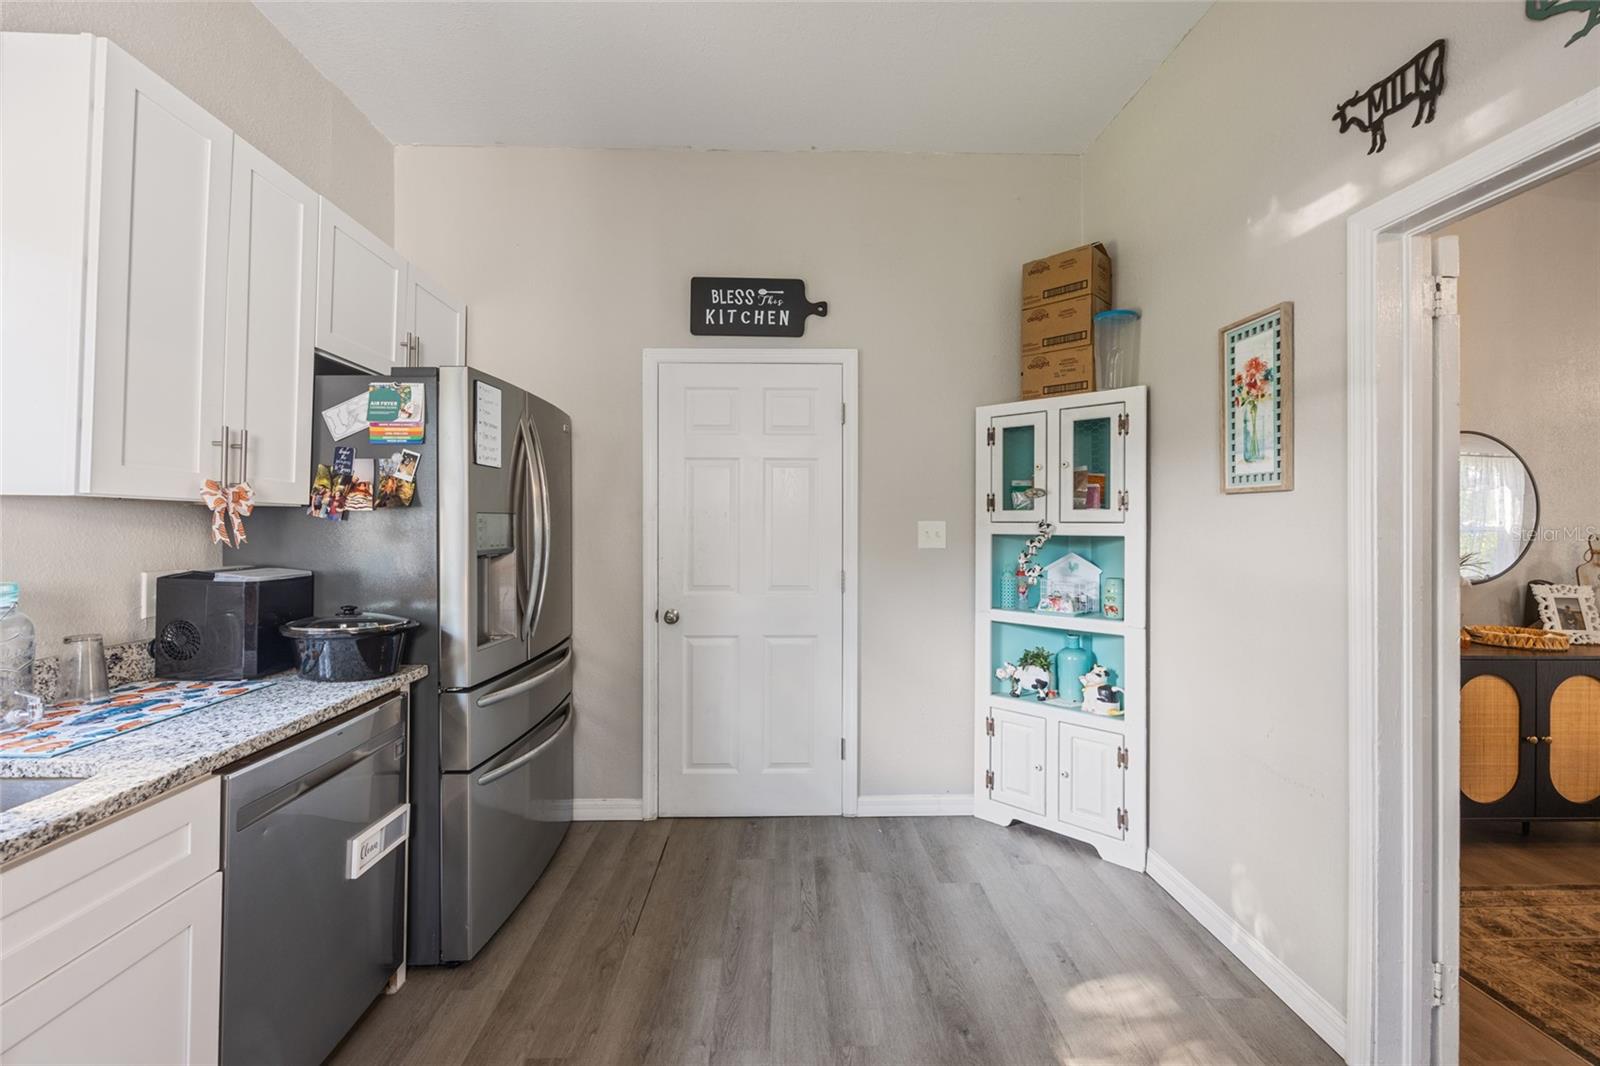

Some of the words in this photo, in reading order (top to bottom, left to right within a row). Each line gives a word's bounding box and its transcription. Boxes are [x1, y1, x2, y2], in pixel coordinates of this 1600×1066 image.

[1367, 49, 1436, 129] MILK
[711, 288, 755, 305] BLESS
[757, 295, 784, 306] This
[705, 309, 790, 326] KITCHEN
[1027, 360, 1050, 370] delight
